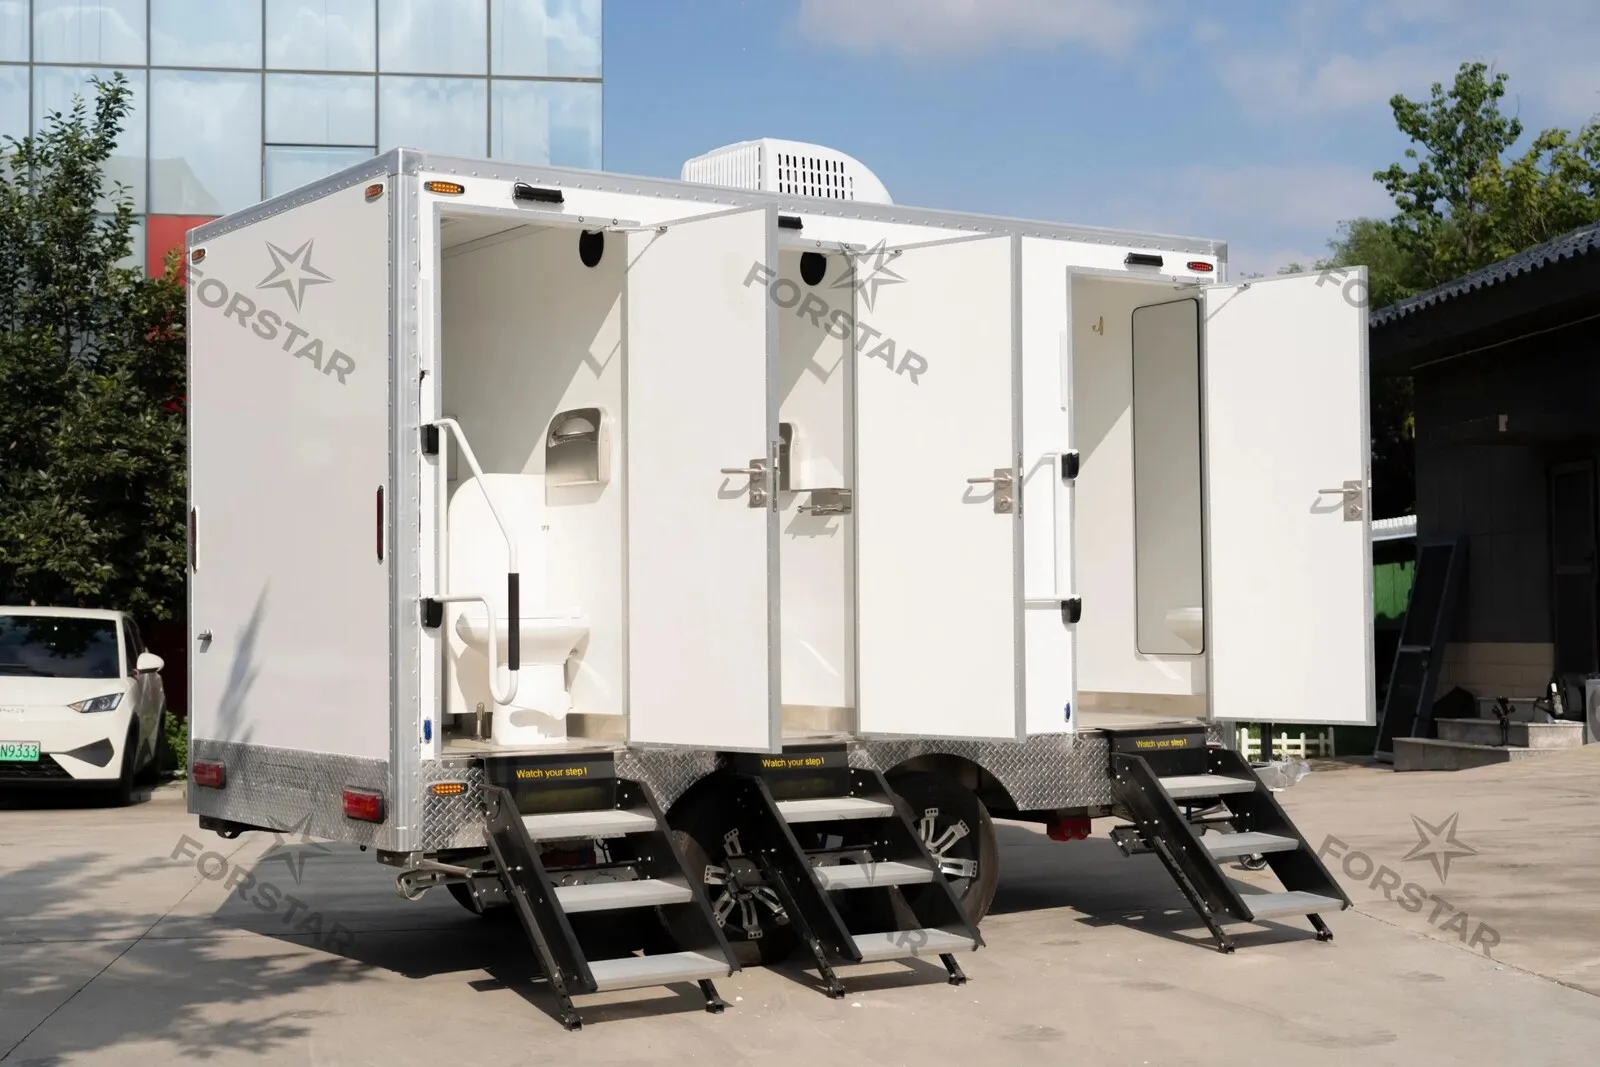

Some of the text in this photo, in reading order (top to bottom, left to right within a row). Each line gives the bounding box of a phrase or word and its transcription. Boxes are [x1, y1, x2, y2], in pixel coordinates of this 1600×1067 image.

[1135, 740, 1156, 749] Watch
[1156, 740, 1170, 749] your
[0, 744, 37, 758] N9333
[761, 758, 787, 768] Watch
[787, 758, 805, 768] your
[515, 768, 544, 779] Watch
[545, 768, 564, 779] your
